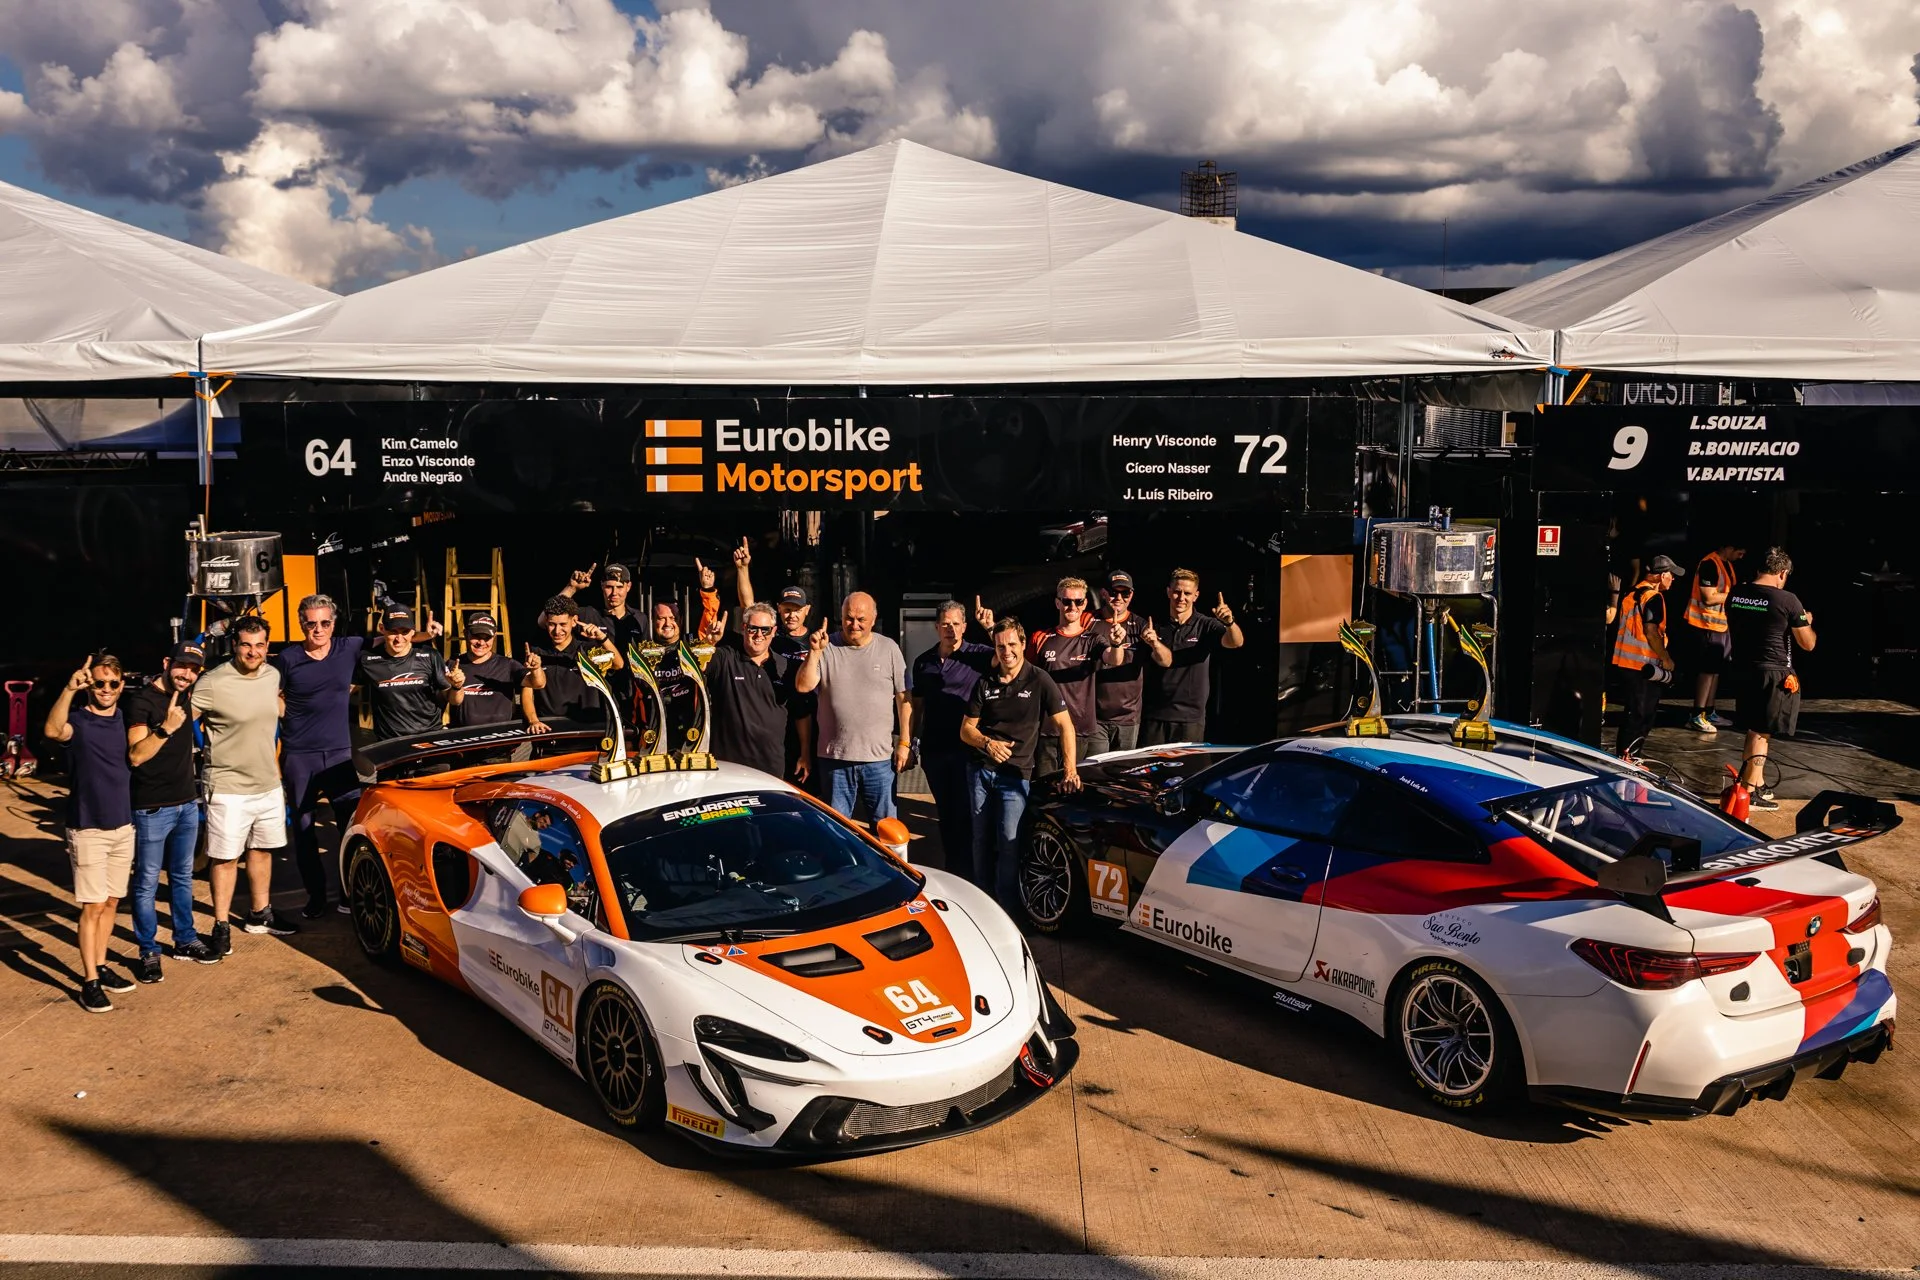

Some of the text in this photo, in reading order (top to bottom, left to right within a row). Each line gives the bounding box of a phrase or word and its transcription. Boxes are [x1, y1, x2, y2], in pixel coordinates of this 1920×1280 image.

[1689, 415, 1767, 430] L.SOUZA
[381, 438, 458, 450] Kim Camelo
[716, 419, 891, 452] Eurobike
[1112, 434, 1217, 449] Henry Visconde
[305, 438, 357, 476] 64
[1234, 434, 1288, 474] 72
[1607, 425, 1649, 470] 9
[1688, 441, 1800, 456] B.BONIFACIO
[381, 455, 475, 467] Enzo Visconde
[1125, 462, 1211, 474] Cícero Nasser
[383, 472, 462, 485] Andre Negrão
[717, 463, 923, 500] Motorsport
[1686, 467, 1785, 481] V.BAPTISTA
[1123, 488, 1214, 501] J. Luís Ribeiro
[1731, 596, 1769, 606] PRODUÇÃO
[1044, 650, 1056, 658] 50
[662, 797, 761, 822] ENDURANCE
[700, 806, 748, 821] BRASIL
[1702, 832, 1862, 871] Eurobike
[1094, 863, 1124, 901] 72
[1092, 901, 1110, 914] GT4
[1152, 907, 1233, 954] Eurobike
[1422, 915, 1481, 945] São Bento
[496, 953, 541, 996] Eurobike
[1411, 962, 1458, 981] PIRELLI
[1331, 968, 1376, 999] AKRAPOVIČ
[545, 978, 570, 1027] 64
[883, 979, 942, 1014] 64
[1272, 991, 1313, 1011] Stuttgart
[544, 1019, 559, 1037] GT4
[905, 1015, 934, 1030] GT4
[671, 1106, 719, 1135] PIRELLI
